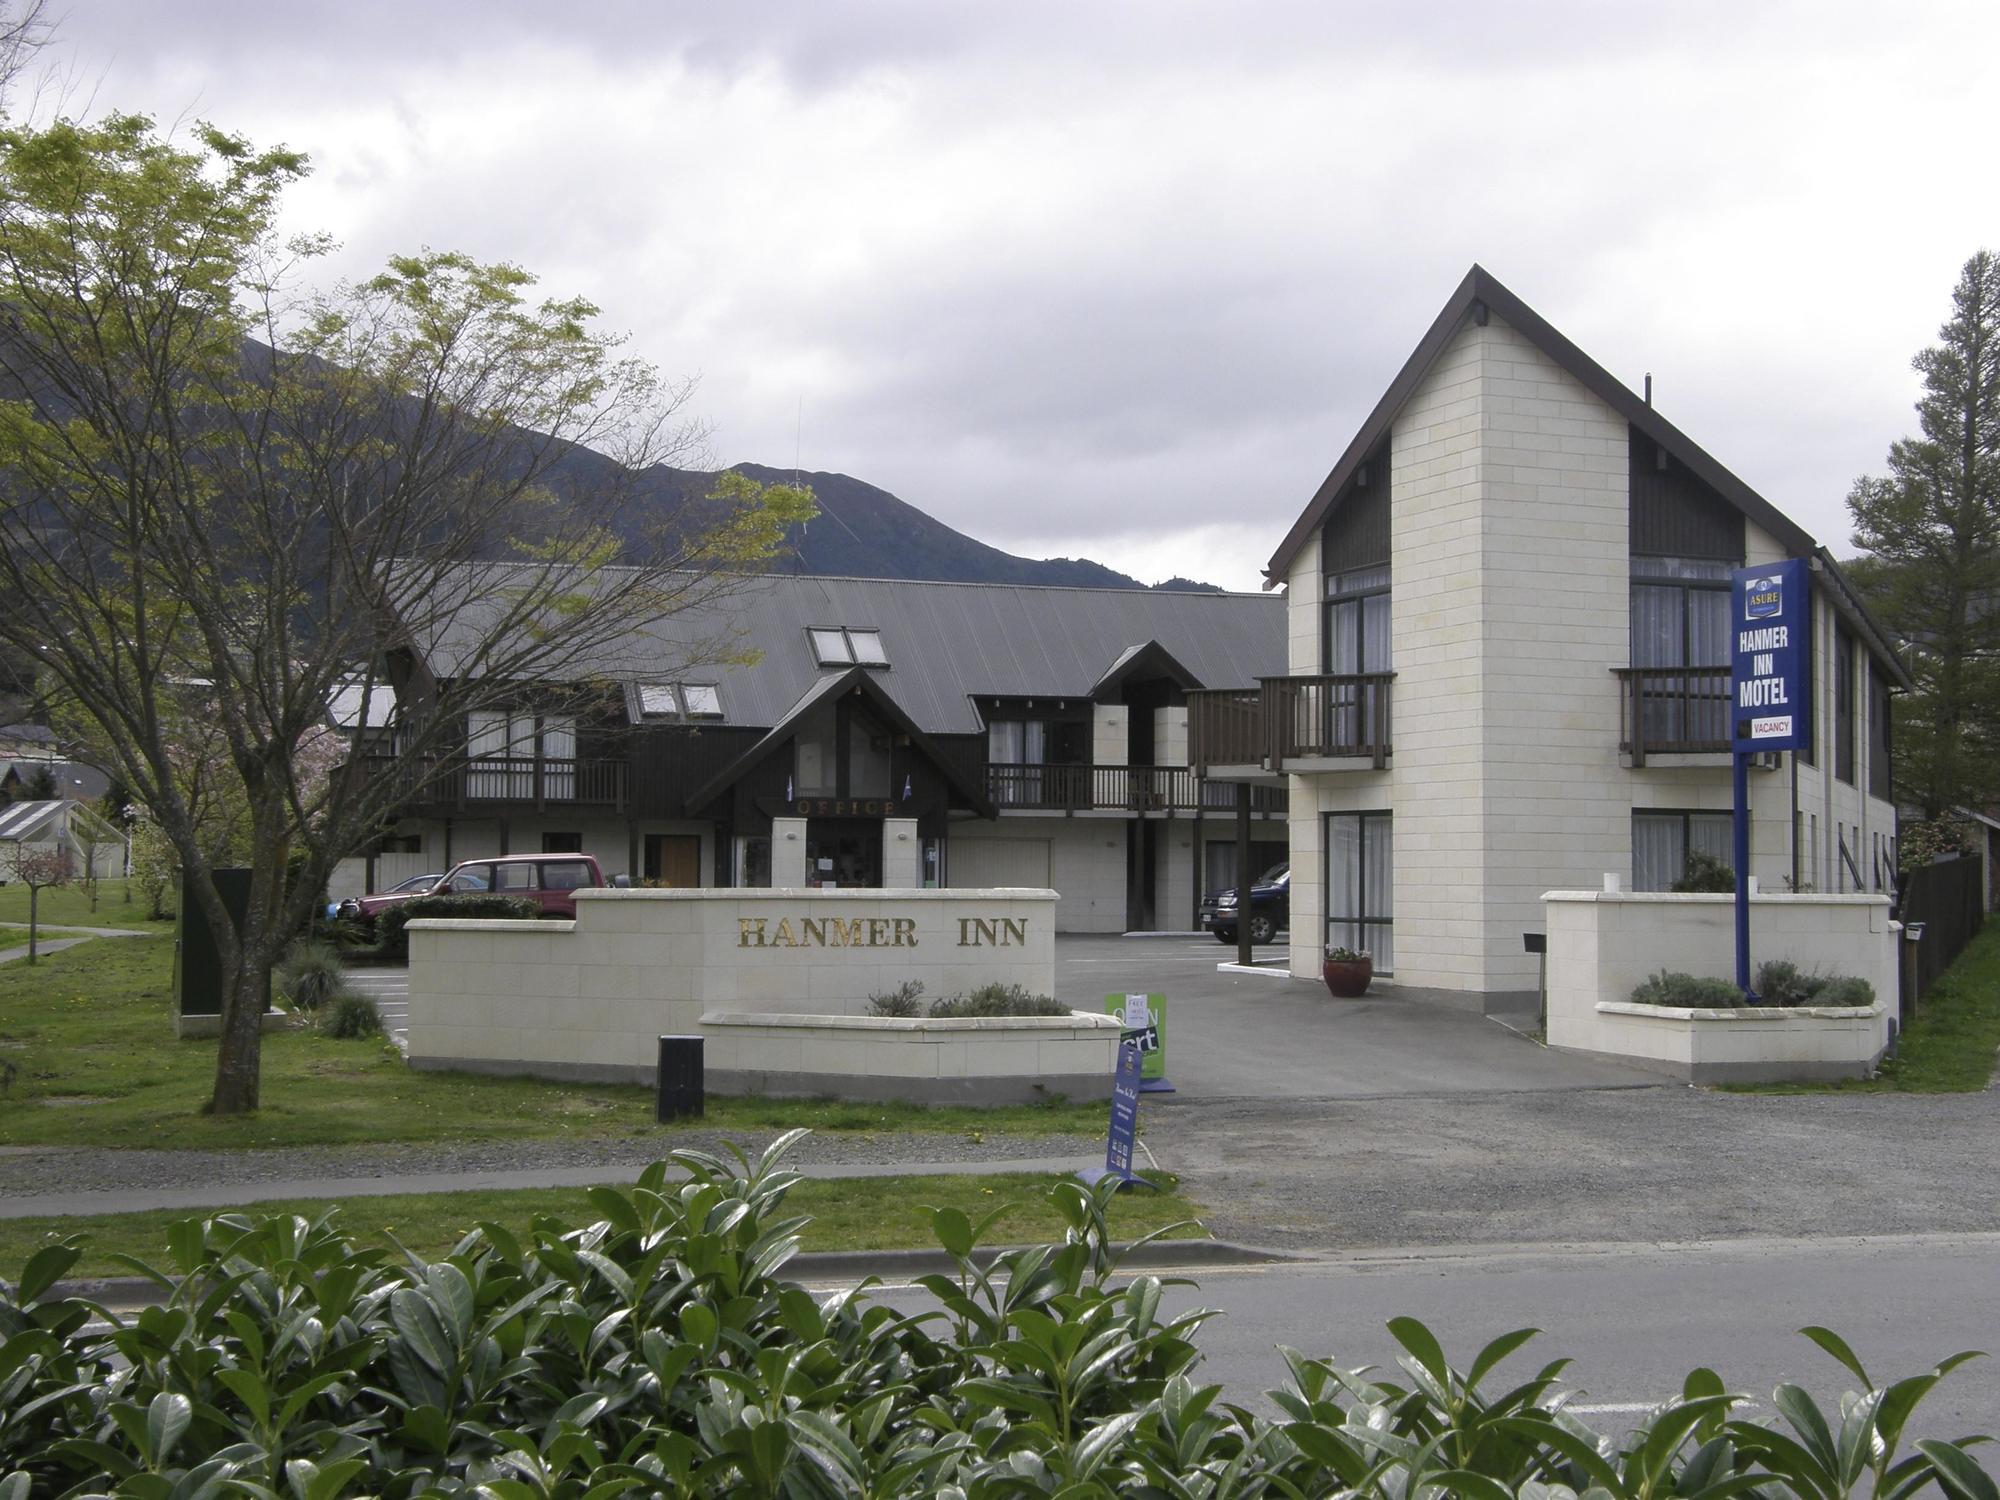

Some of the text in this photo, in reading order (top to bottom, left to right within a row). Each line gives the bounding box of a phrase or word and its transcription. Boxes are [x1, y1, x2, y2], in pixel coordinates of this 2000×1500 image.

[1750, 592, 1778, 606] ASURE
[1739, 625, 1788, 653] HANMER
[1753, 653, 1773, 677] INN
[1739, 677, 1788, 708] MOTEL
[1754, 720, 1790, 734] VACANCY
[797, 799, 895, 815] OFFICE
[736, 917, 1028, 948] HANMER INN
[1113, 1007, 1159, 1027] ON
